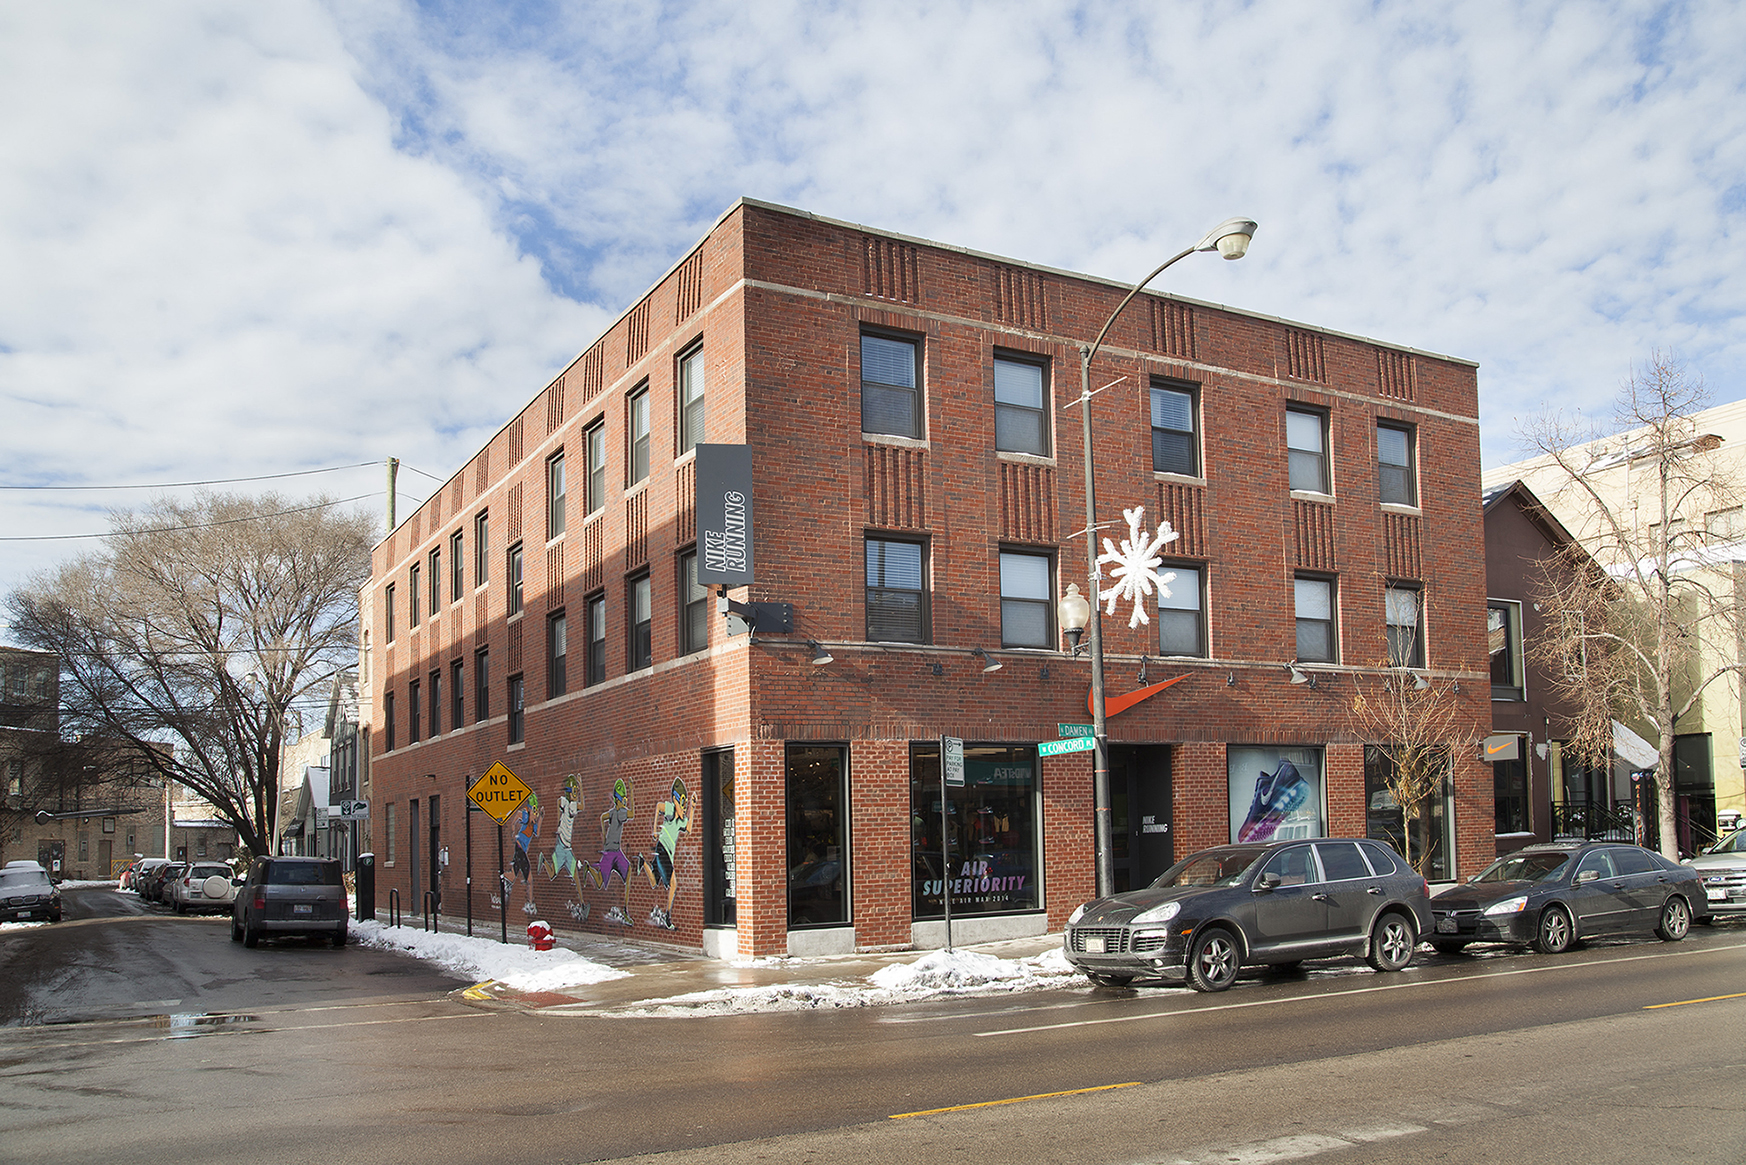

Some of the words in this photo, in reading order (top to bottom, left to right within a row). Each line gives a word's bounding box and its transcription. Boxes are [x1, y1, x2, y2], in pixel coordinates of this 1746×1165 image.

[724, 490, 746, 572] RUNNING
[705, 530, 726, 572] NIKE
[1065, 725, 1088, 736] DAMEN
[1047, 740, 1084, 754] CONCORD
[489, 775, 508, 785] NO
[476, 790, 523, 802] OUTLET
[1143, 815, 1155, 824] NIKE
[1143, 824, 1168, 833] RUNNING
[961, 861, 988, 876] AIR
